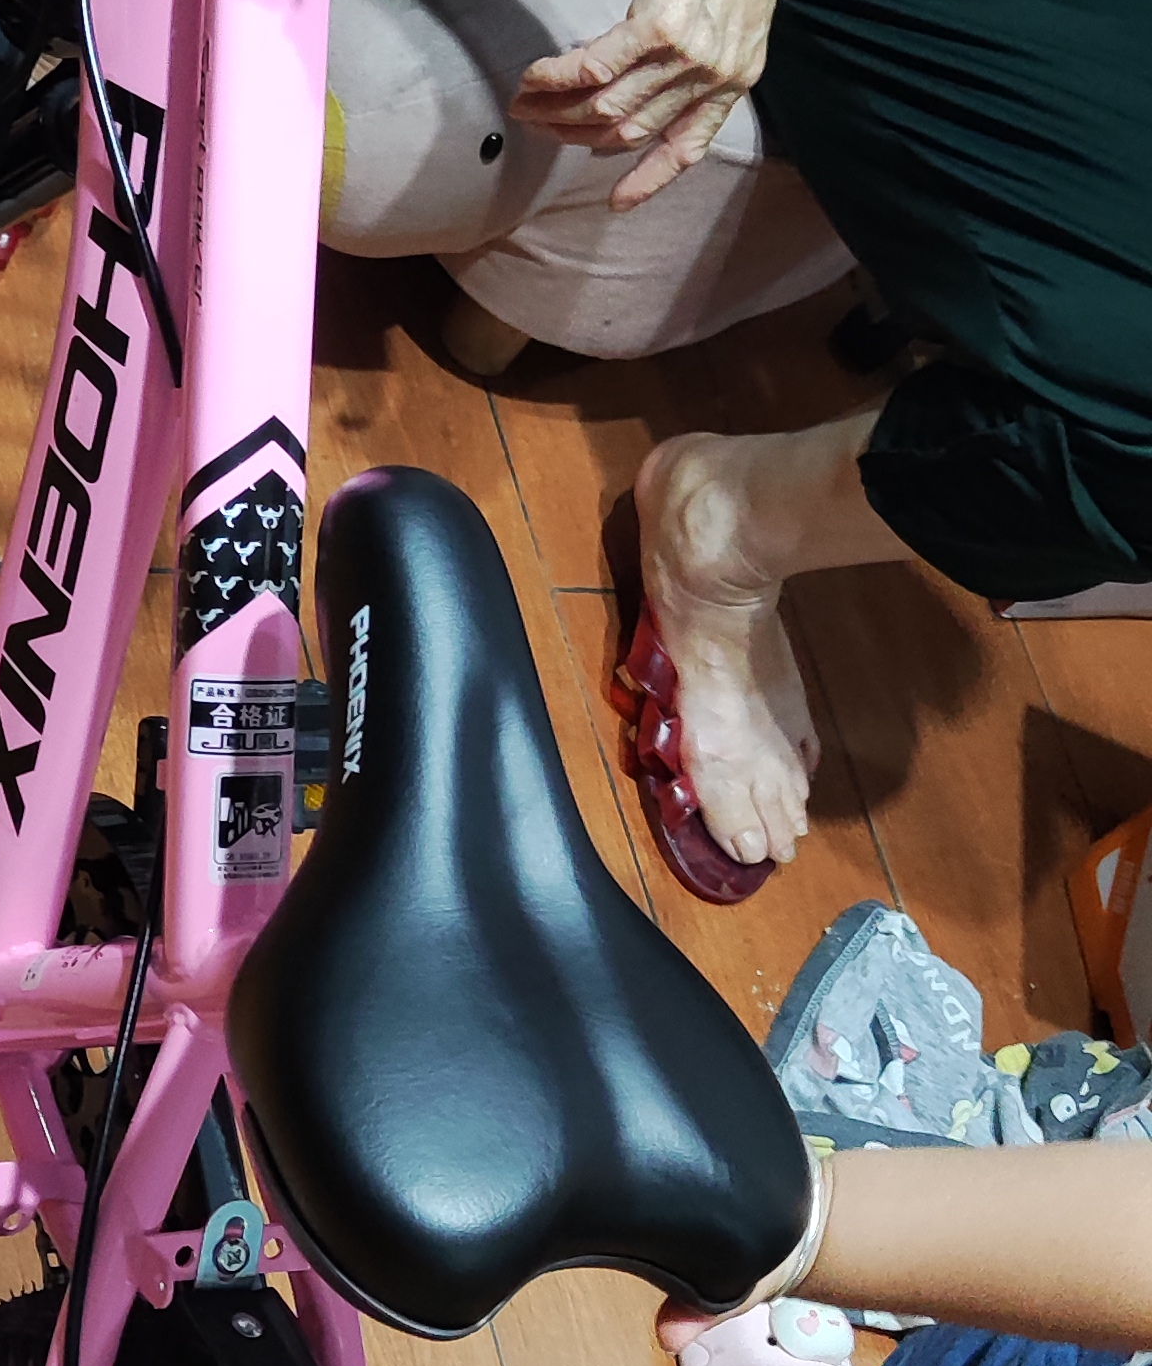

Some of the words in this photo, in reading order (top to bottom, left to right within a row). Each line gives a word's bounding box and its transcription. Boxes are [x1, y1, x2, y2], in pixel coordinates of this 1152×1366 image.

[209, 703, 288, 728] 合格证
[341, 604, 371, 785] PHOENIX
